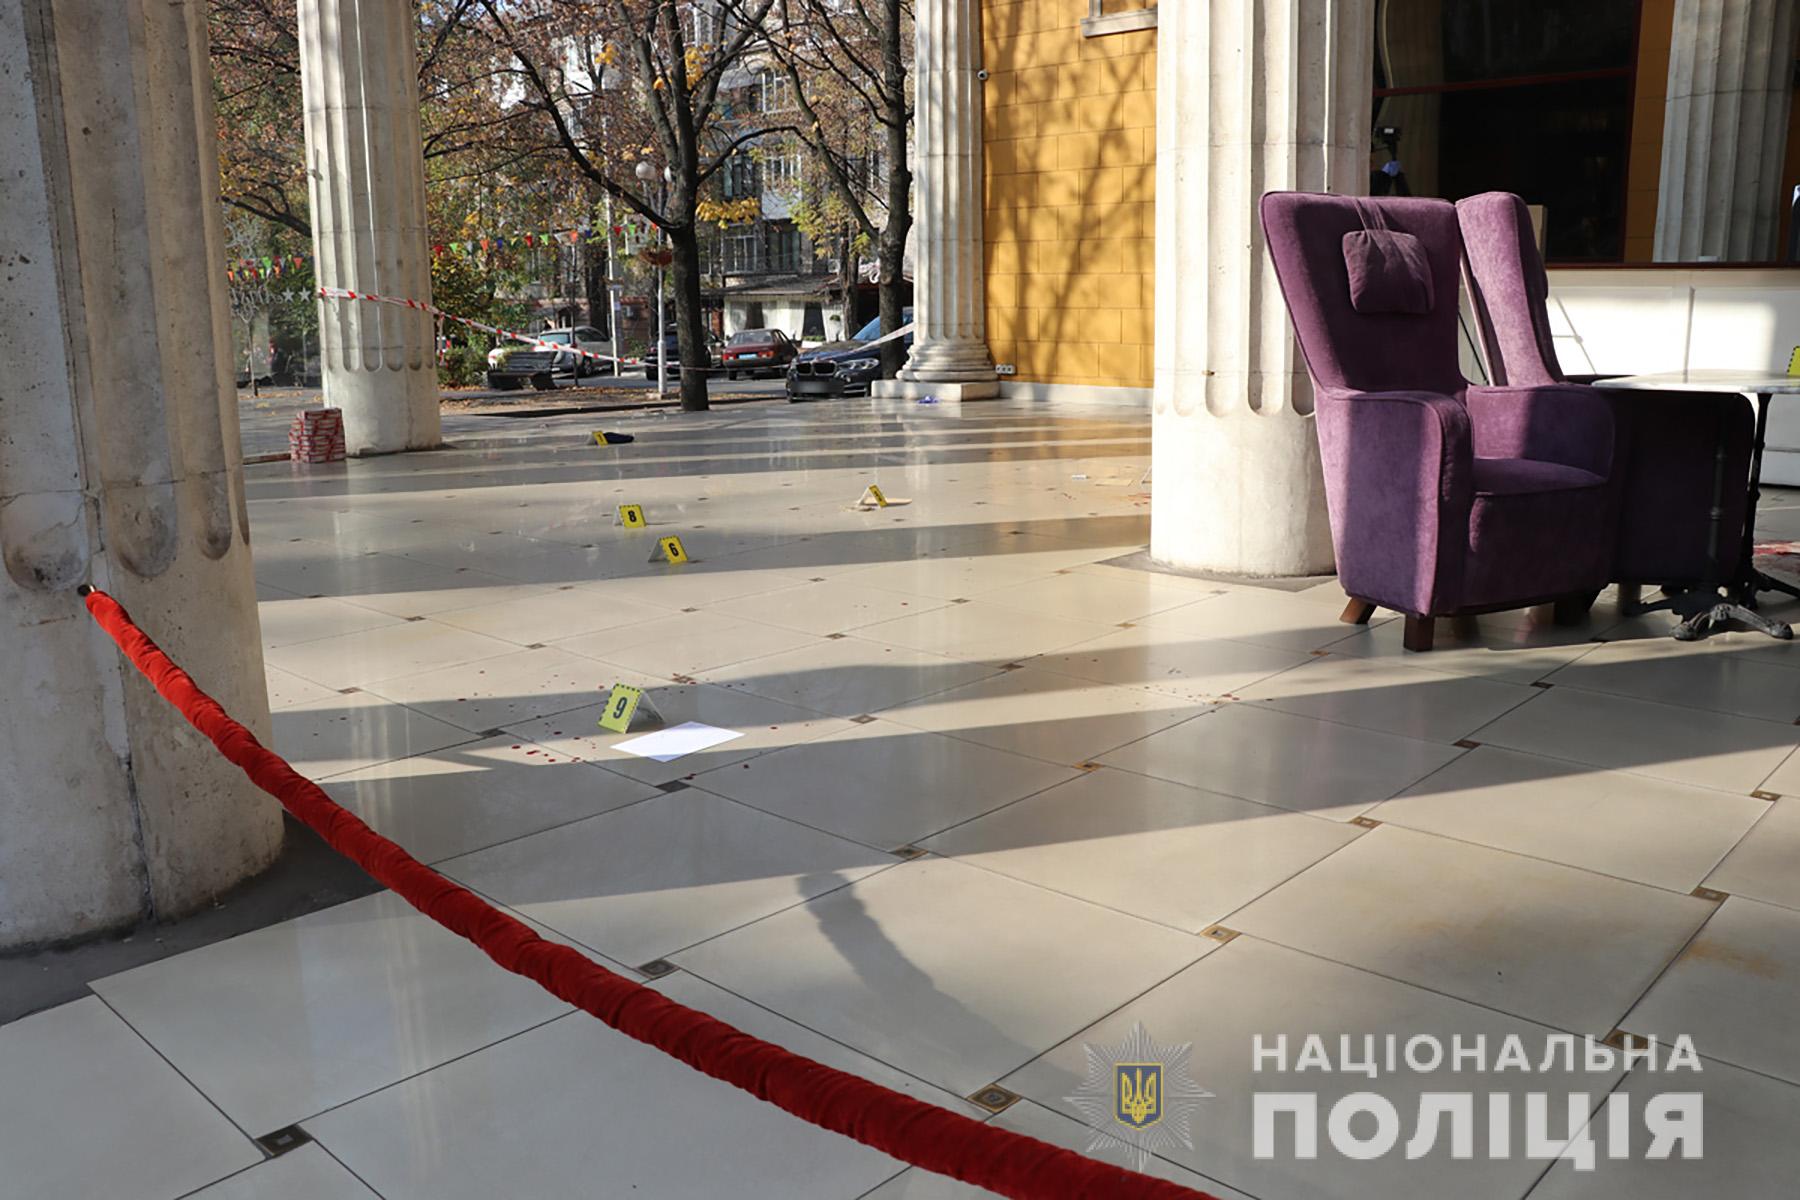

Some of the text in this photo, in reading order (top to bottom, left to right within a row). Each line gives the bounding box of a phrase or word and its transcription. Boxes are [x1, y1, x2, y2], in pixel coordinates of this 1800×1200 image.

[627, 510, 637, 523] 8
[668, 542, 679, 557] 6
[613, 696, 628, 719] 9
